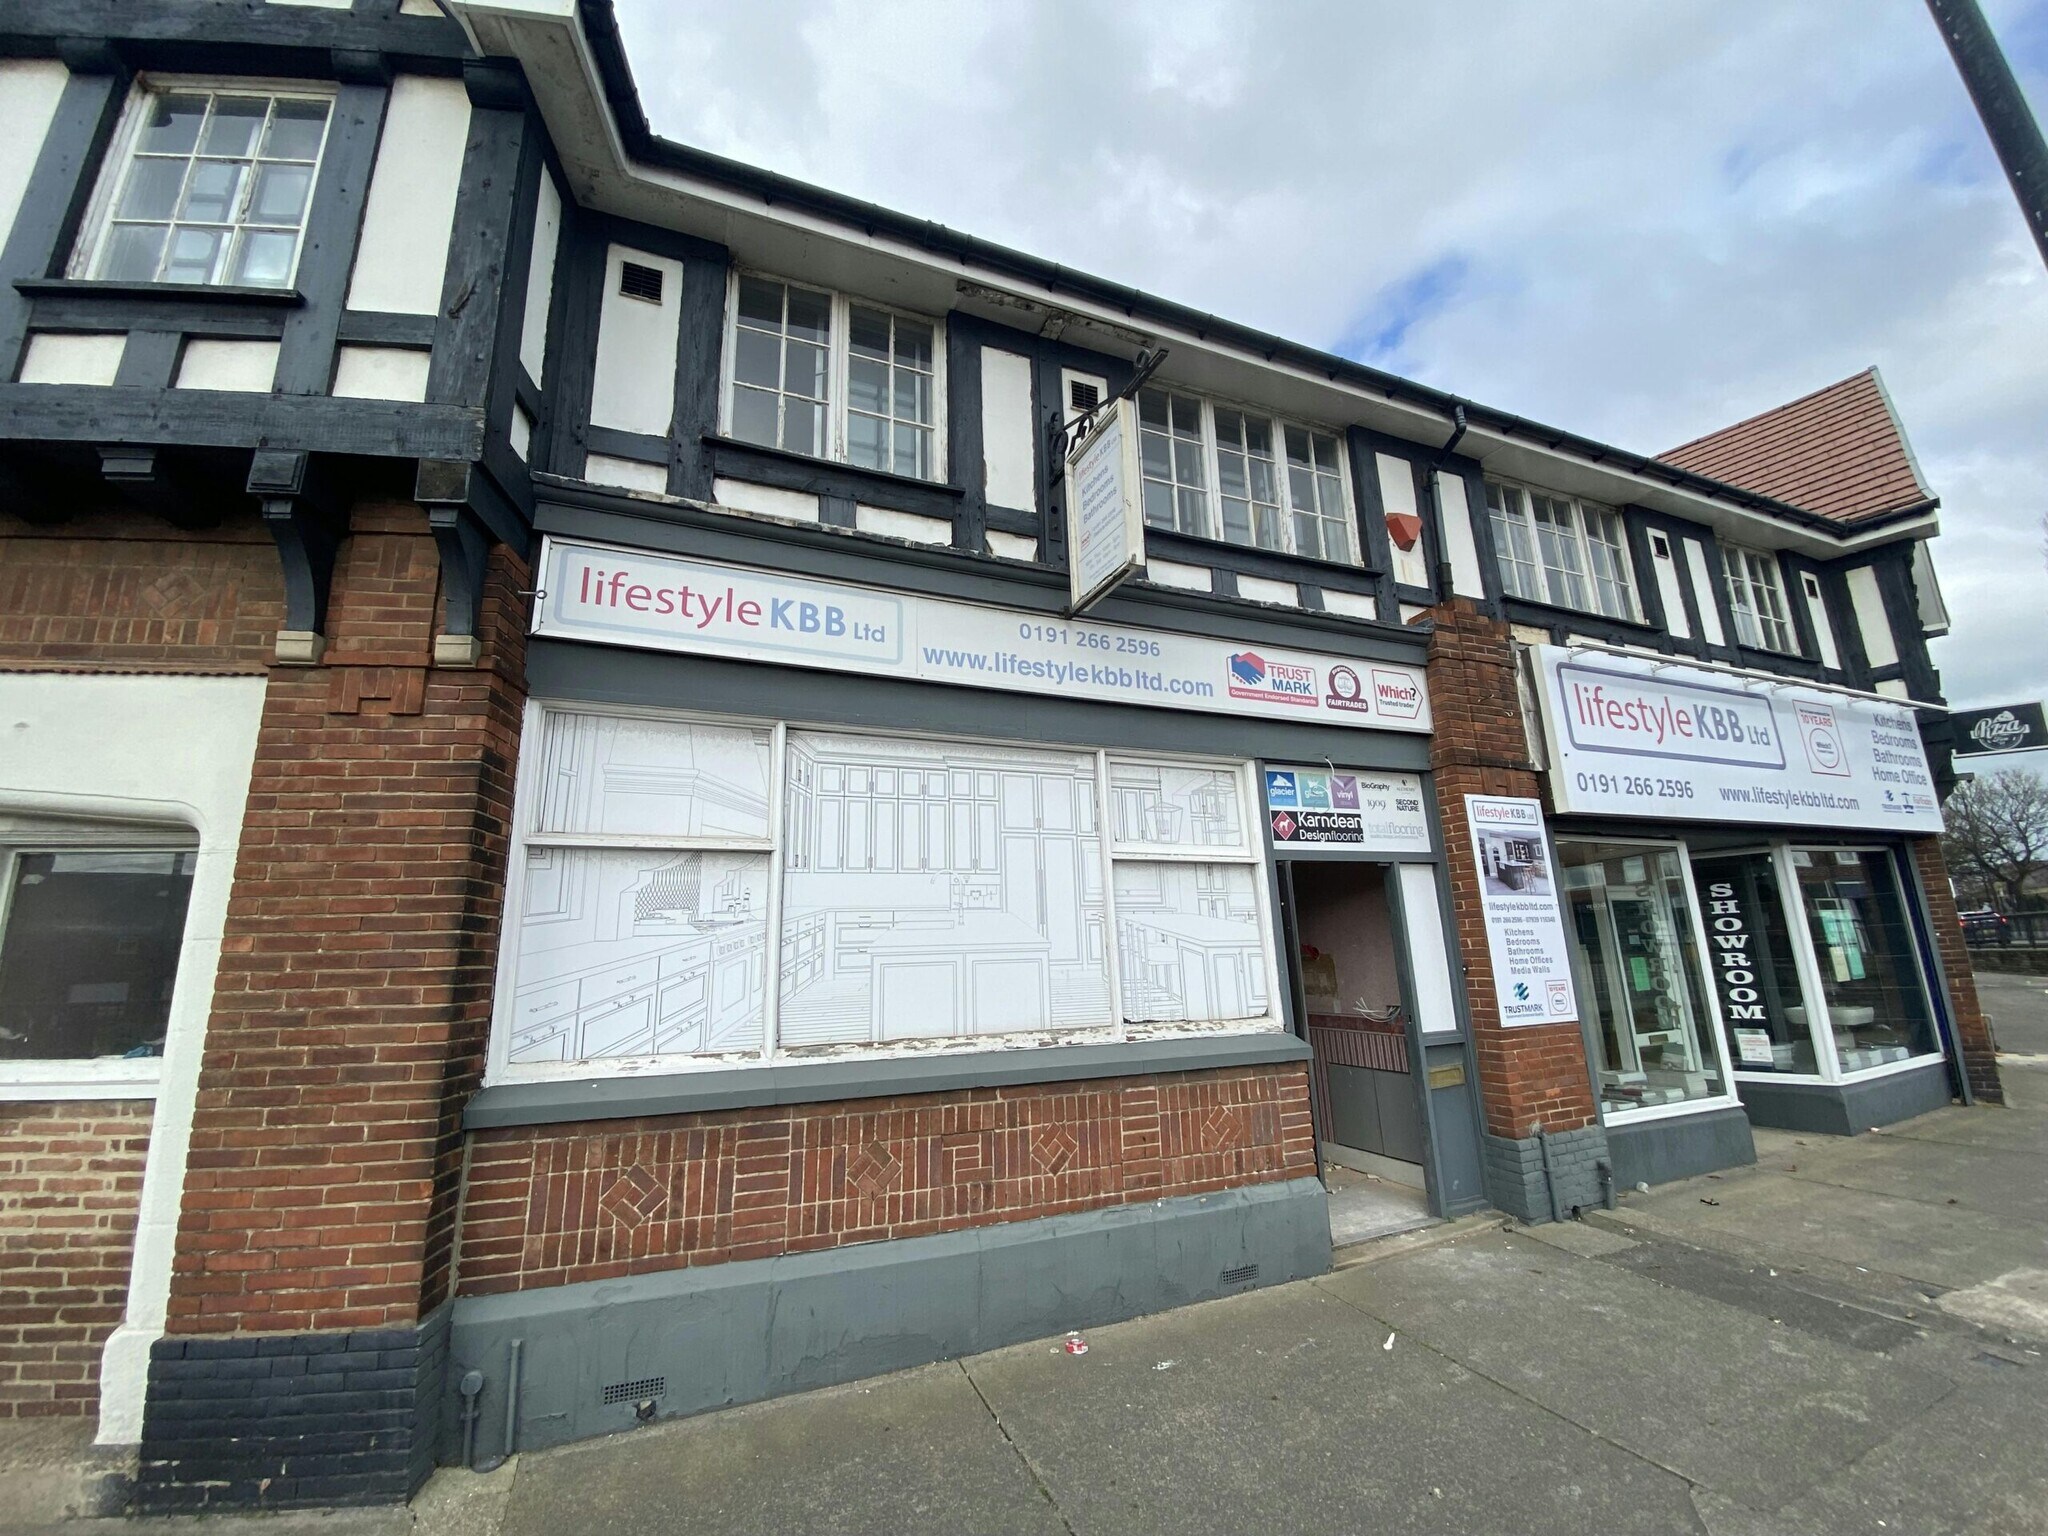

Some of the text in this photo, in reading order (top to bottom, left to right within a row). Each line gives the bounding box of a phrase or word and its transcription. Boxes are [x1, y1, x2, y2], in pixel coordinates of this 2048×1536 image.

[853, 624, 885, 643] Ltd
[1019, 623, 1160, 657] 0191 266 2596
[923, 647, 1214, 697] www.lifestylekbbltd.com
[1268, 665, 1311, 682] TRUST
[1272, 678, 1312, 695] MARK
[1377, 684, 1416, 701] Which?
[1231, 690, 1316, 705] Government Endorsed Standards
[1327, 698, 1367, 710] FAIRTRADES
[1809, 715, 1832, 727] YEARS
[1873, 713, 1913, 732] Kitchens
[1747, 725, 1771, 746] Ltd
[1871, 730, 1918, 749] Bedrooms
[1872, 748, 1922, 767] Bathrooms
[1872, 766, 1927, 786] Home Office
[1269, 787, 1295, 797] glacier
[1577, 772, 1693, 798] 0191 266 2596
[1337, 791, 1354, 800] vinyl
[1719, 787, 1860, 810] www.lifestylekbbltd.com
[1297, 811, 1363, 829] Karndean
[1489, 902, 1553, 912] lifestylekbbltd.com
[1504, 928, 1534, 936] Kitchens
[1506, 938, 1540, 946] Bedrooms
[1507, 947, 1544, 955] Bathrooms
[1709, 883, 1766, 1019] SHOWROOM
[1509, 956, 1553, 965] Home Offices
[1511, 965, 1550, 974] Media Walls
[1504, 1004, 1543, 1014] TRUSTMARK
